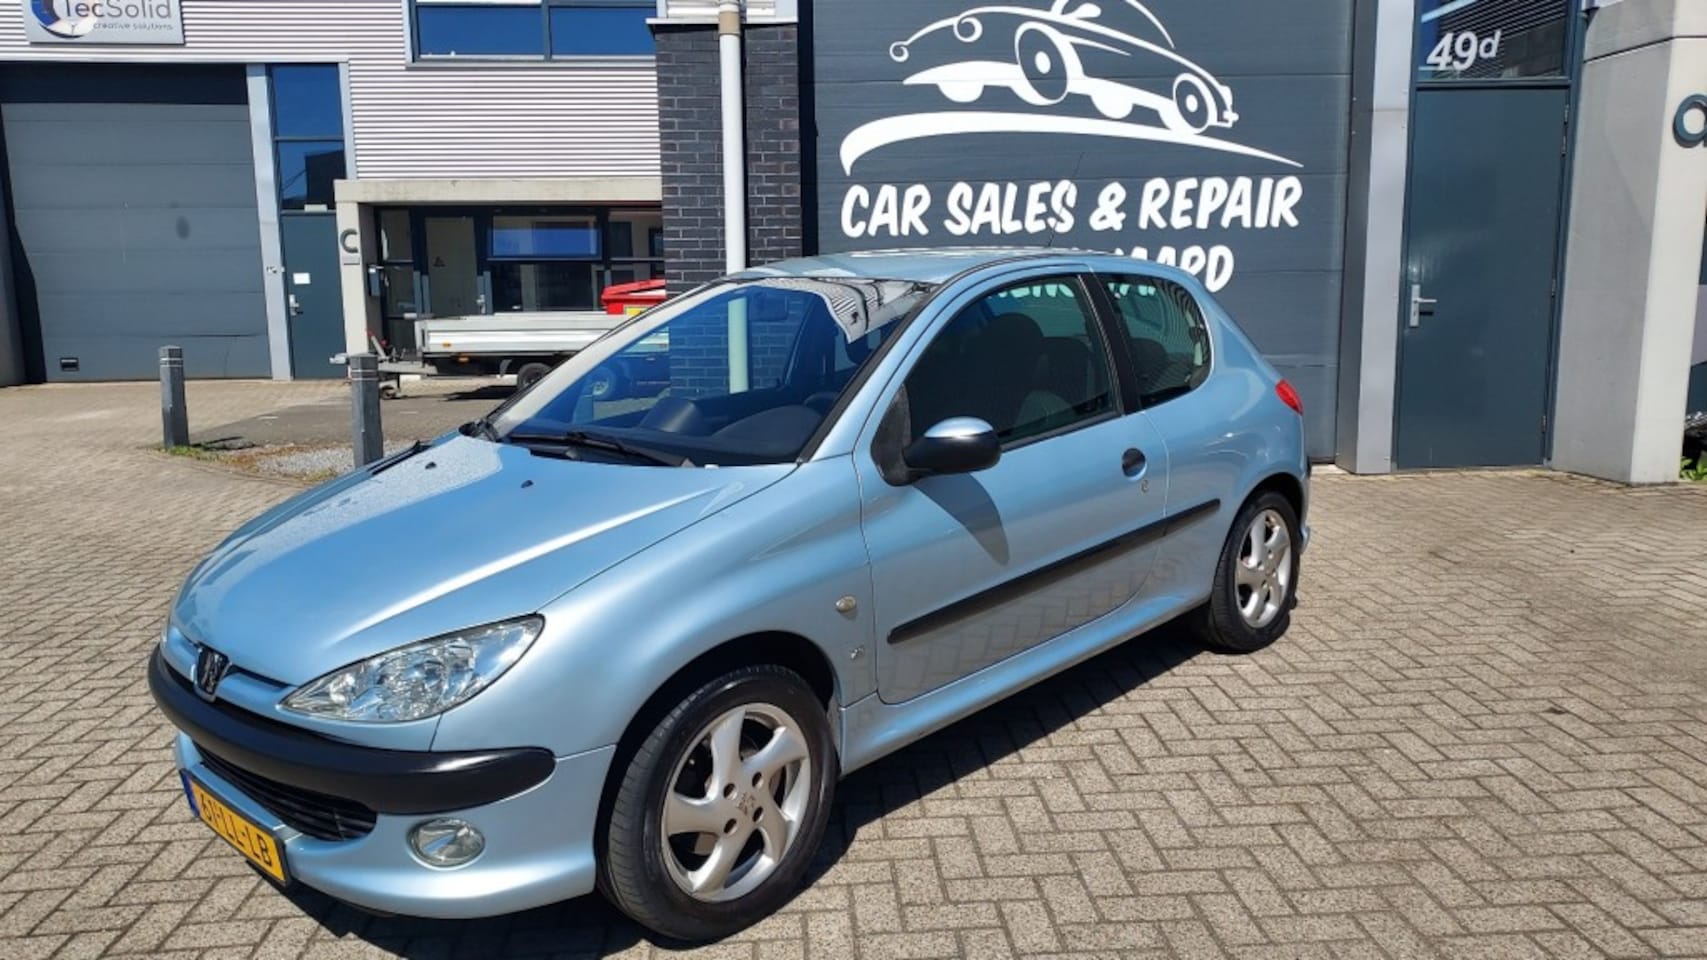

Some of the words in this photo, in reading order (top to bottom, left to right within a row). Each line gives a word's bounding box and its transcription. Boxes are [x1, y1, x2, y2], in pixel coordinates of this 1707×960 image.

[93, 22, 130, 30] creative
[1426, 30, 1501, 71] 49d
[841, 183, 931, 238] CAR
[944, 179, 1078, 236] SALES
[1089, 181, 1127, 231] &
[1138, 175, 1303, 230] REPAIR
